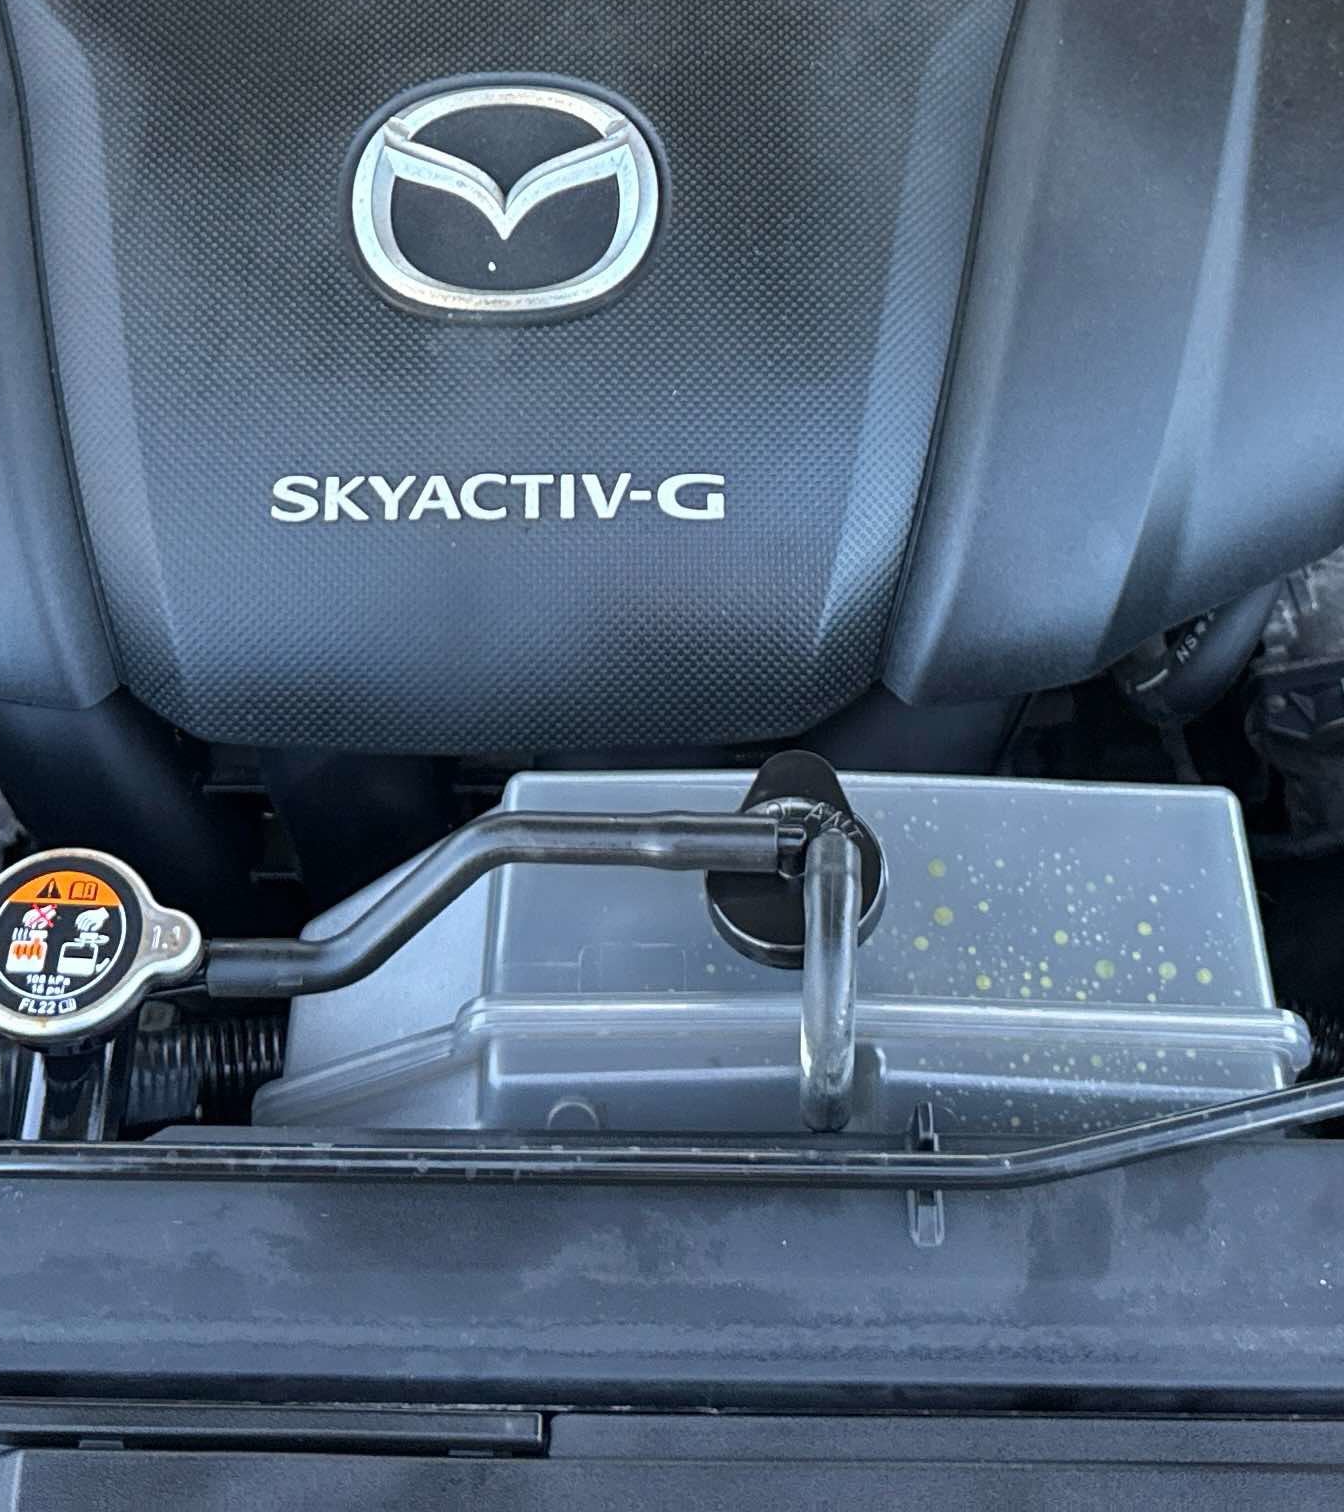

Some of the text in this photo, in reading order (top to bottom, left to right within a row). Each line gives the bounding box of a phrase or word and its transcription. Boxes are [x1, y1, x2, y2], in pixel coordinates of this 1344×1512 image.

[270, 471, 726, 523] SKYACTIV-G
[151, 924, 181, 950] 1.1
[47, 974, 71, 986] kPa
[45, 984, 66, 997] psi
[18, 997, 57, 1015] FL22
